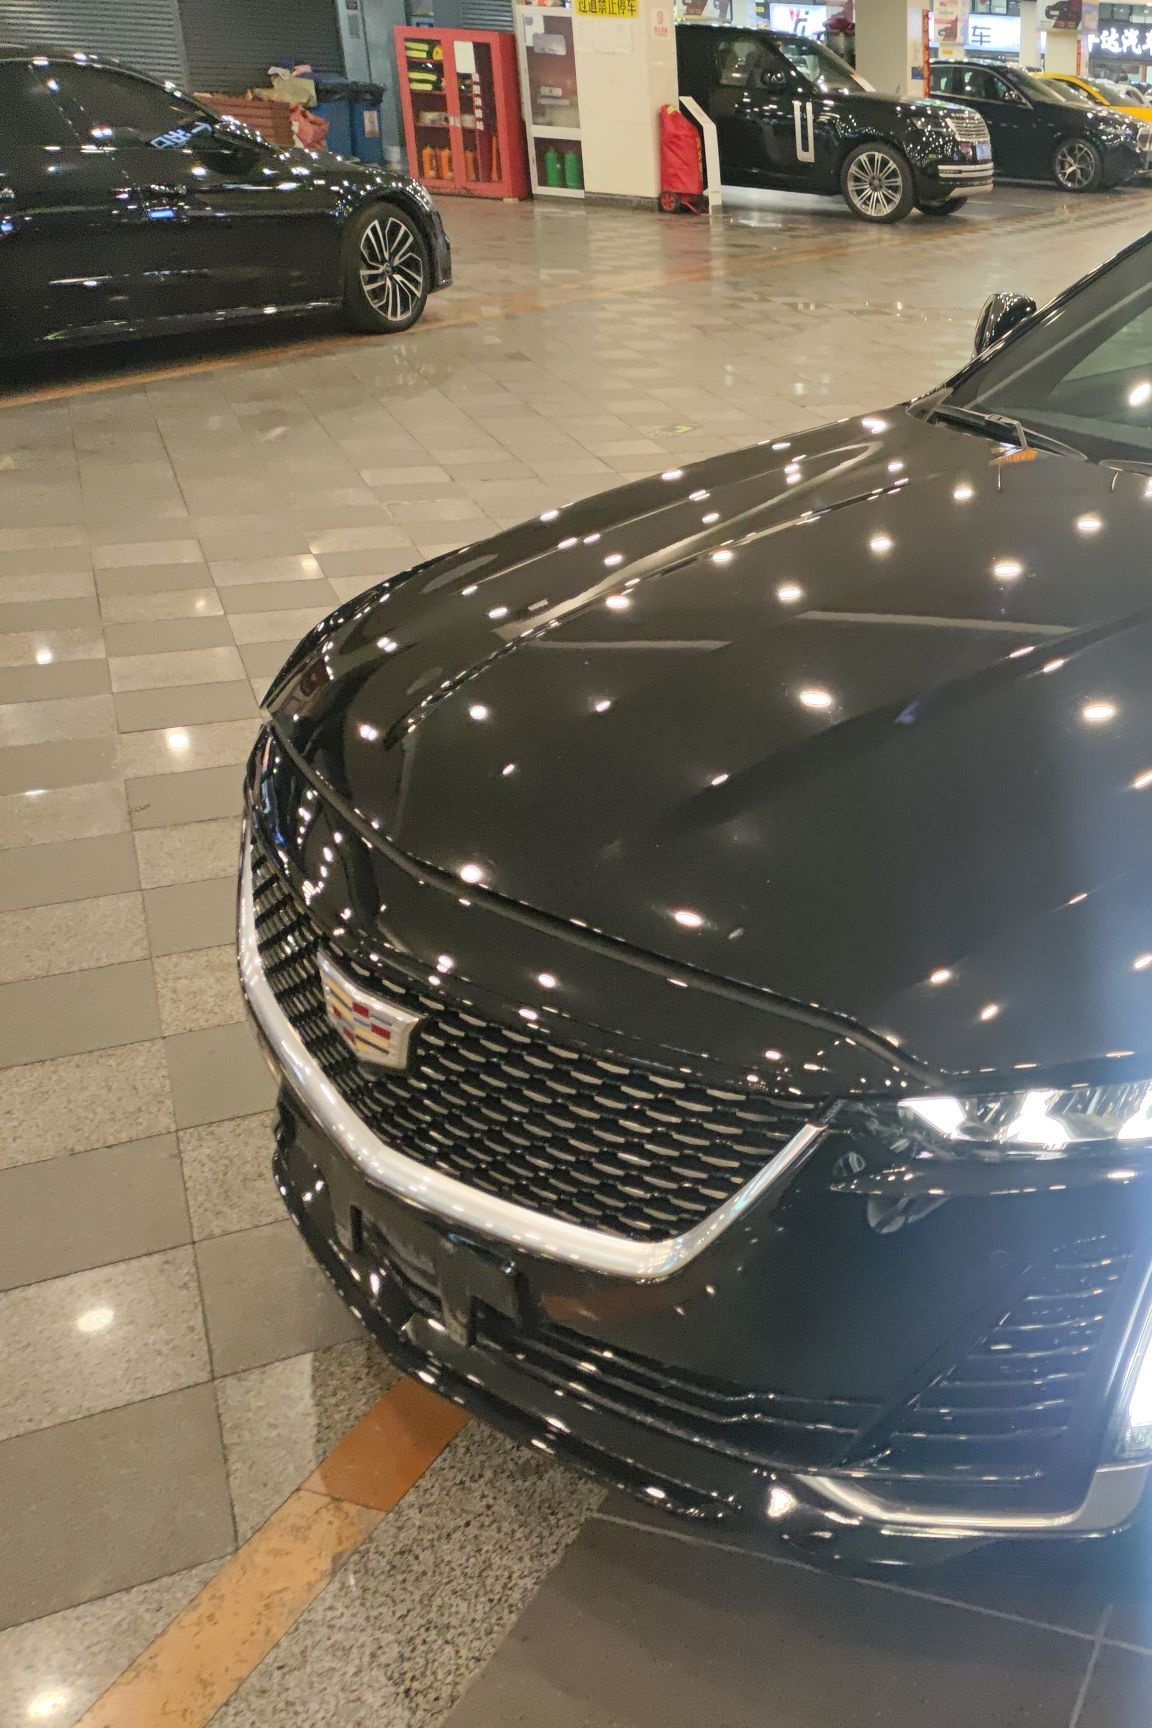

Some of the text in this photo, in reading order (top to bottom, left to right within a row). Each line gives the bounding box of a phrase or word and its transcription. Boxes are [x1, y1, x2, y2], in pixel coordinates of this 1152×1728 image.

[577, 0, 637, 17] 过道禁止停车
[971, 24, 992, 46] 车
